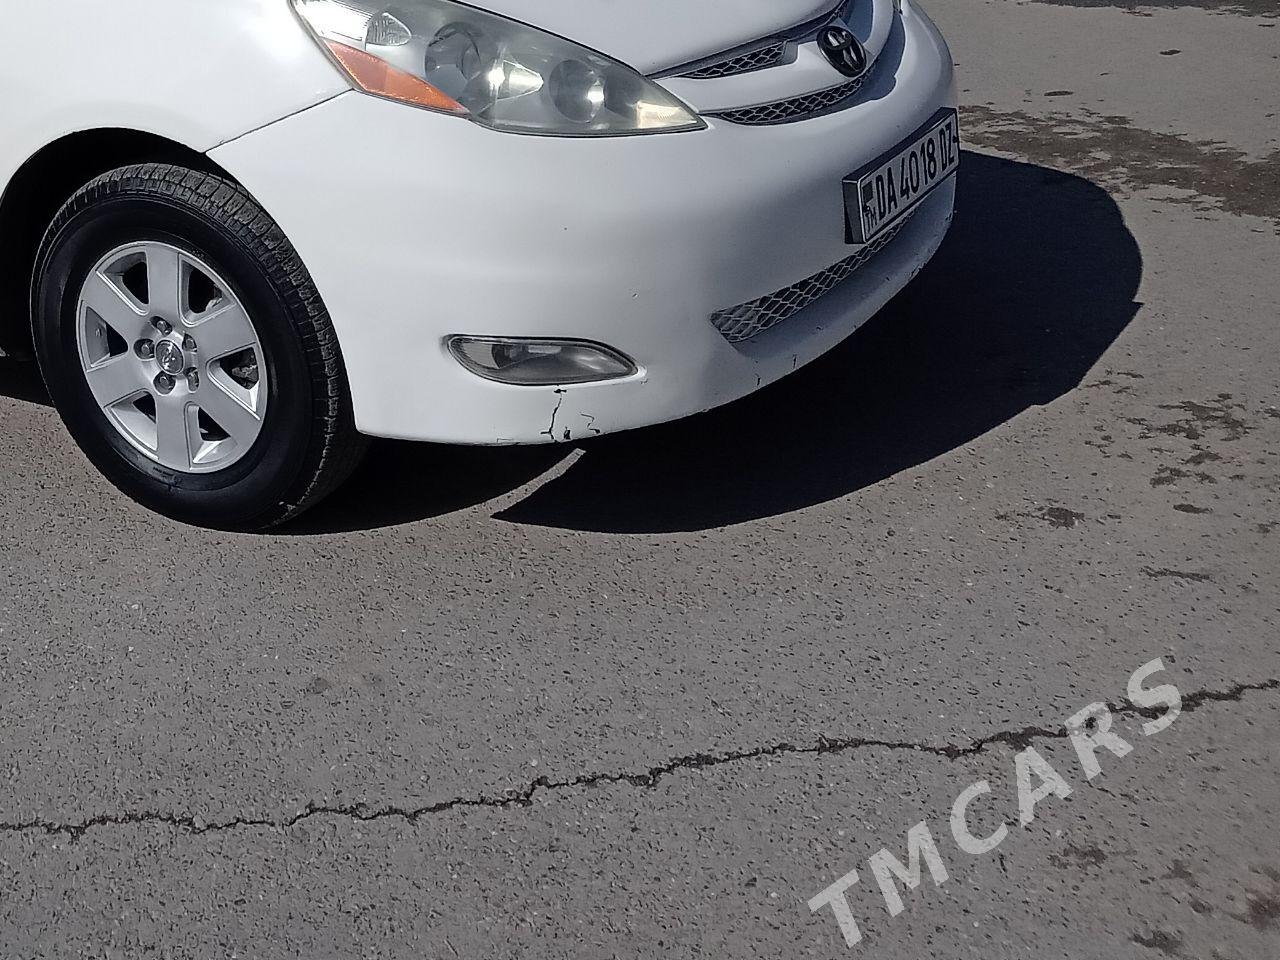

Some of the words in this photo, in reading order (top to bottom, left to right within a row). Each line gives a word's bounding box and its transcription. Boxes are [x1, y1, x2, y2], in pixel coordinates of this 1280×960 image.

[875, 166, 897, 220] DA
[899, 137, 937, 200] 4018
[938, 121, 955, 172] DZ
